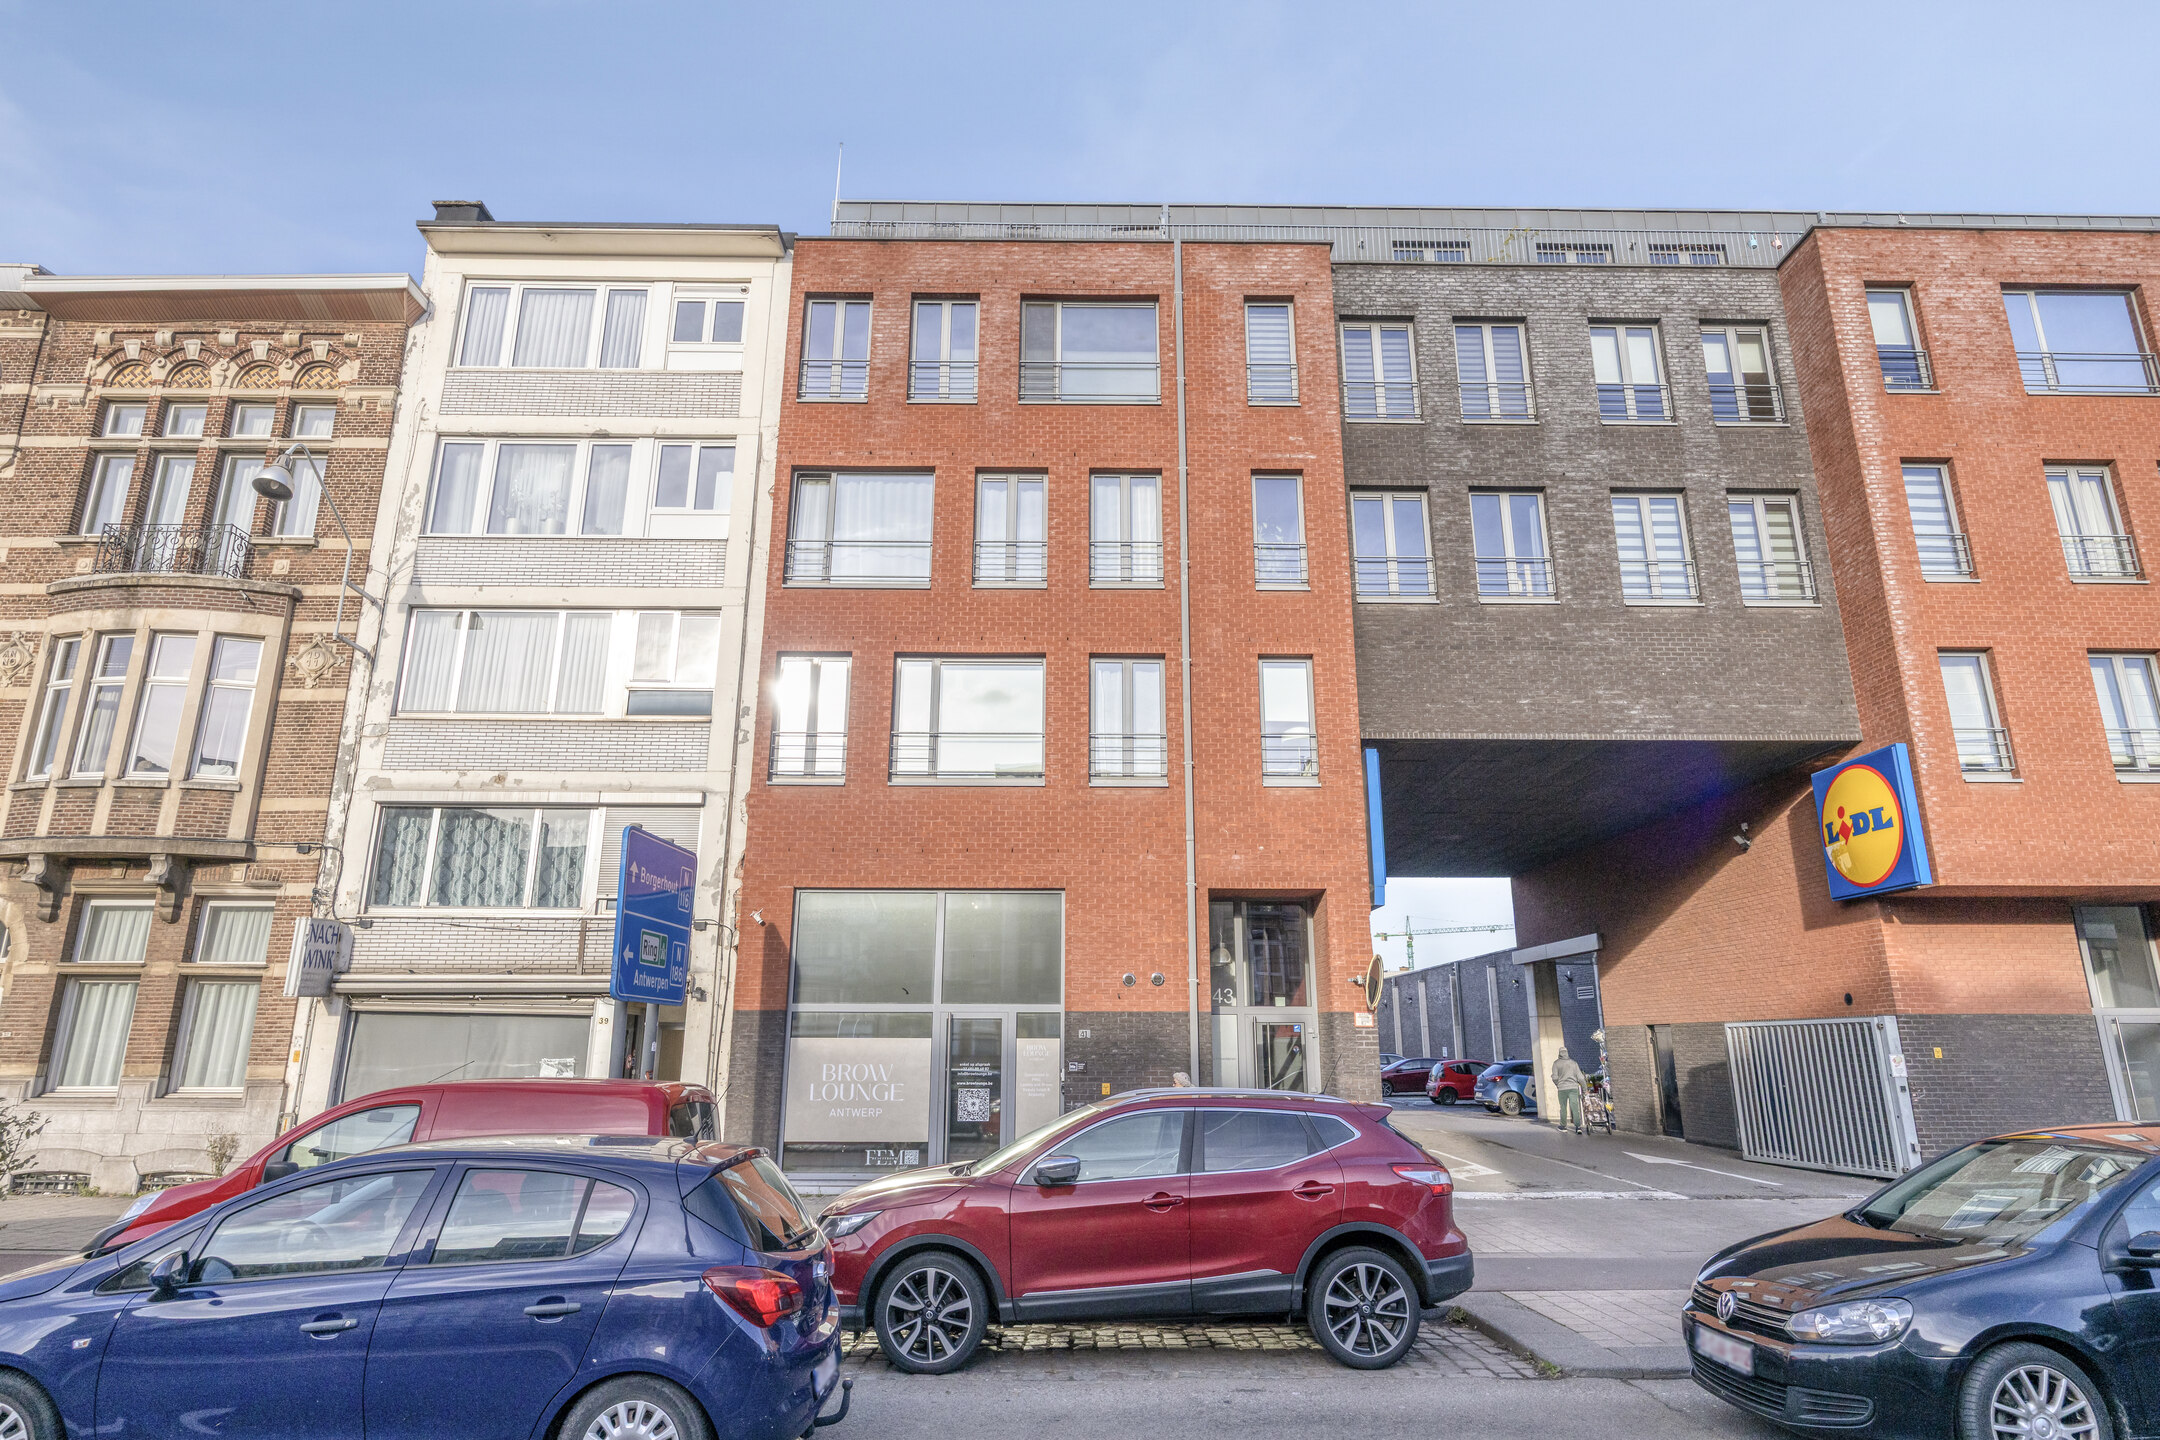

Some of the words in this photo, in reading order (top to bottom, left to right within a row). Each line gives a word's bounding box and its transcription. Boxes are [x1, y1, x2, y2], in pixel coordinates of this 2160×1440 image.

[640, 866, 678, 895] Borgerhout
[683, 871, 690, 887] N
[680, 892, 690, 909] 116
[309, 922, 341, 945] NACH
[302, 949, 335, 970] WINK
[643, 938, 659, 963] Ring
[676, 946, 682, 962] N
[633, 969, 669, 992] Antwerpen
[671, 965, 683, 983] 186
[1212, 988, 1234, 1004] 43
[598, 1017, 609, 1025] 39
[822, 1063, 894, 1082] BROW
[809, 1083, 905, 1102] LOUNGE
[829, 1107, 883, 1118] ANTWERP
[865, 1149, 905, 1166] FEM
